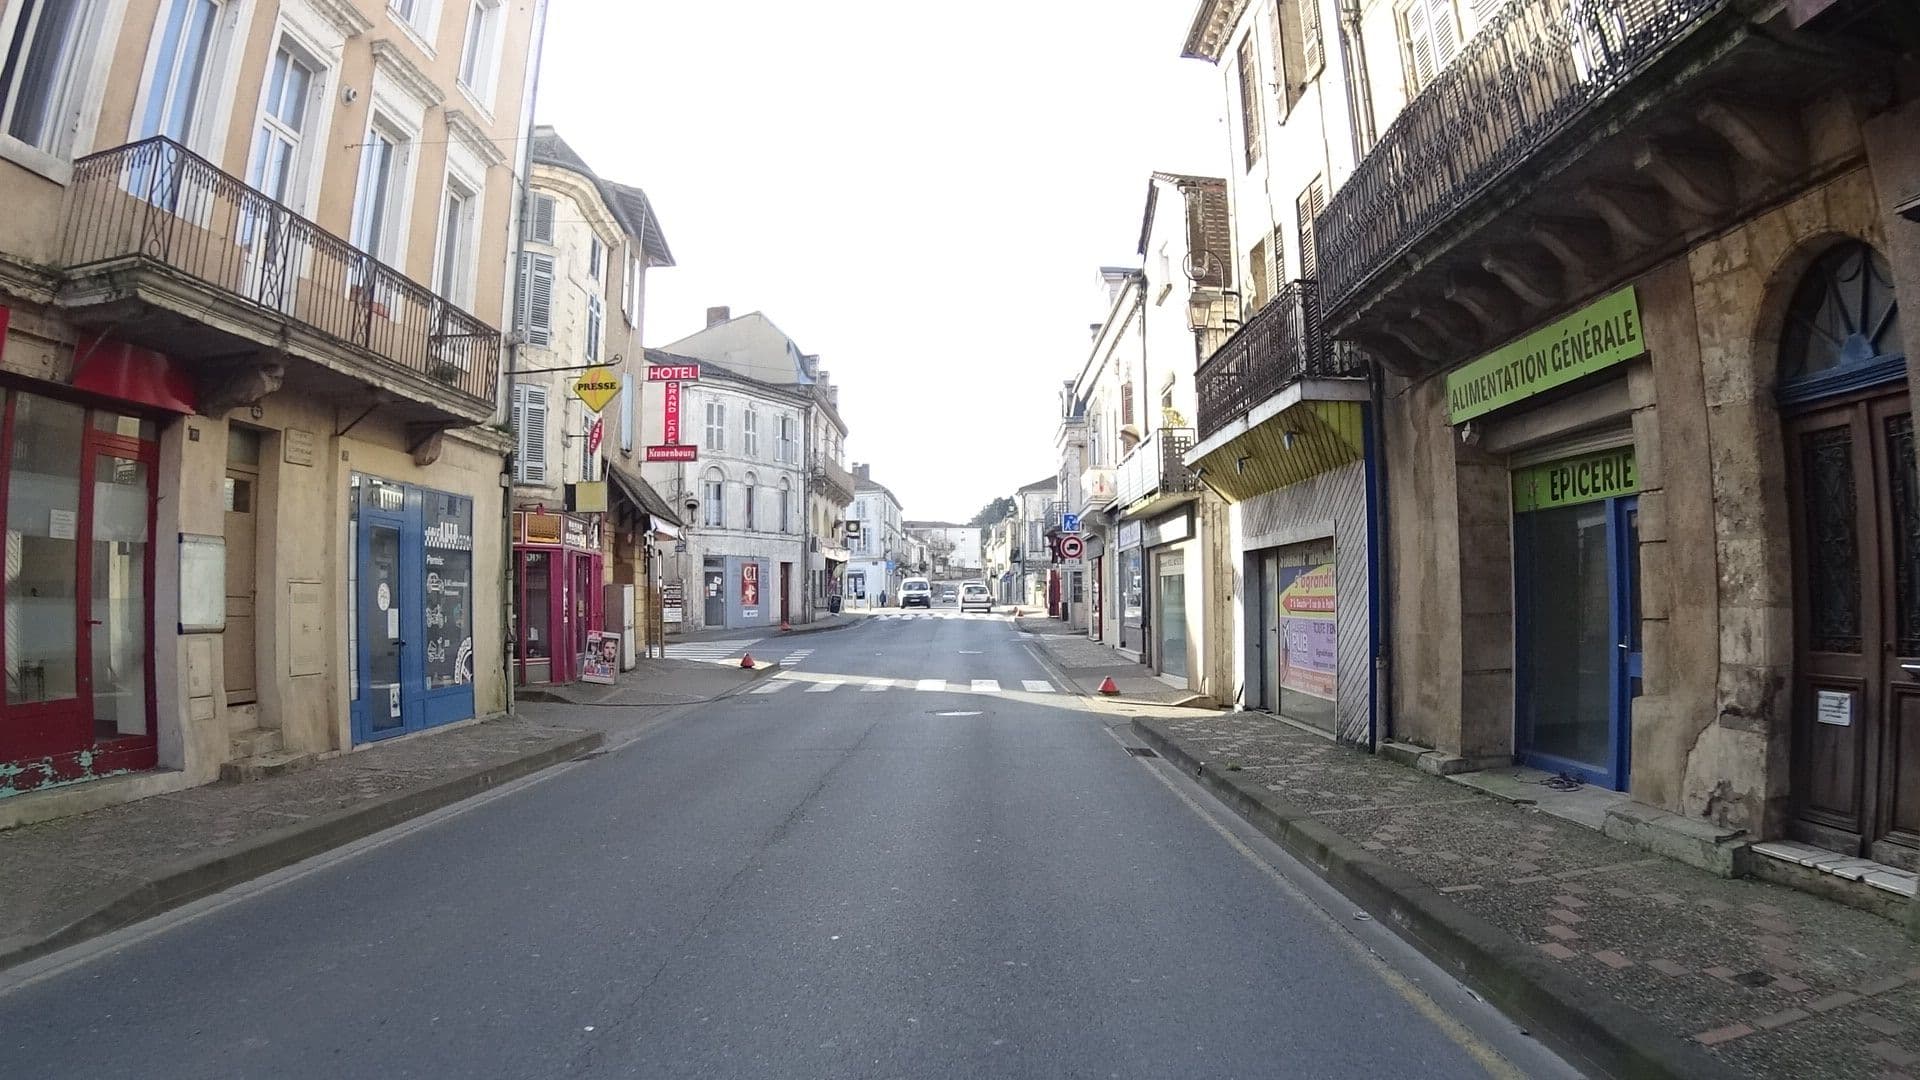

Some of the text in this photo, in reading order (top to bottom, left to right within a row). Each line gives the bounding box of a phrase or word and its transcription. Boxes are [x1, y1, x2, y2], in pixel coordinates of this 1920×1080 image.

[649, 367, 697, 379] HOTEL
[1452, 309, 1636, 413] ALIMENTATION GÉNÉRALE
[577, 382, 617, 391] PRESSE
[667, 382, 678, 413] GRAND
[591, 422, 602, 449] TABAC
[1550, 452, 1634, 502] EPICERIE
